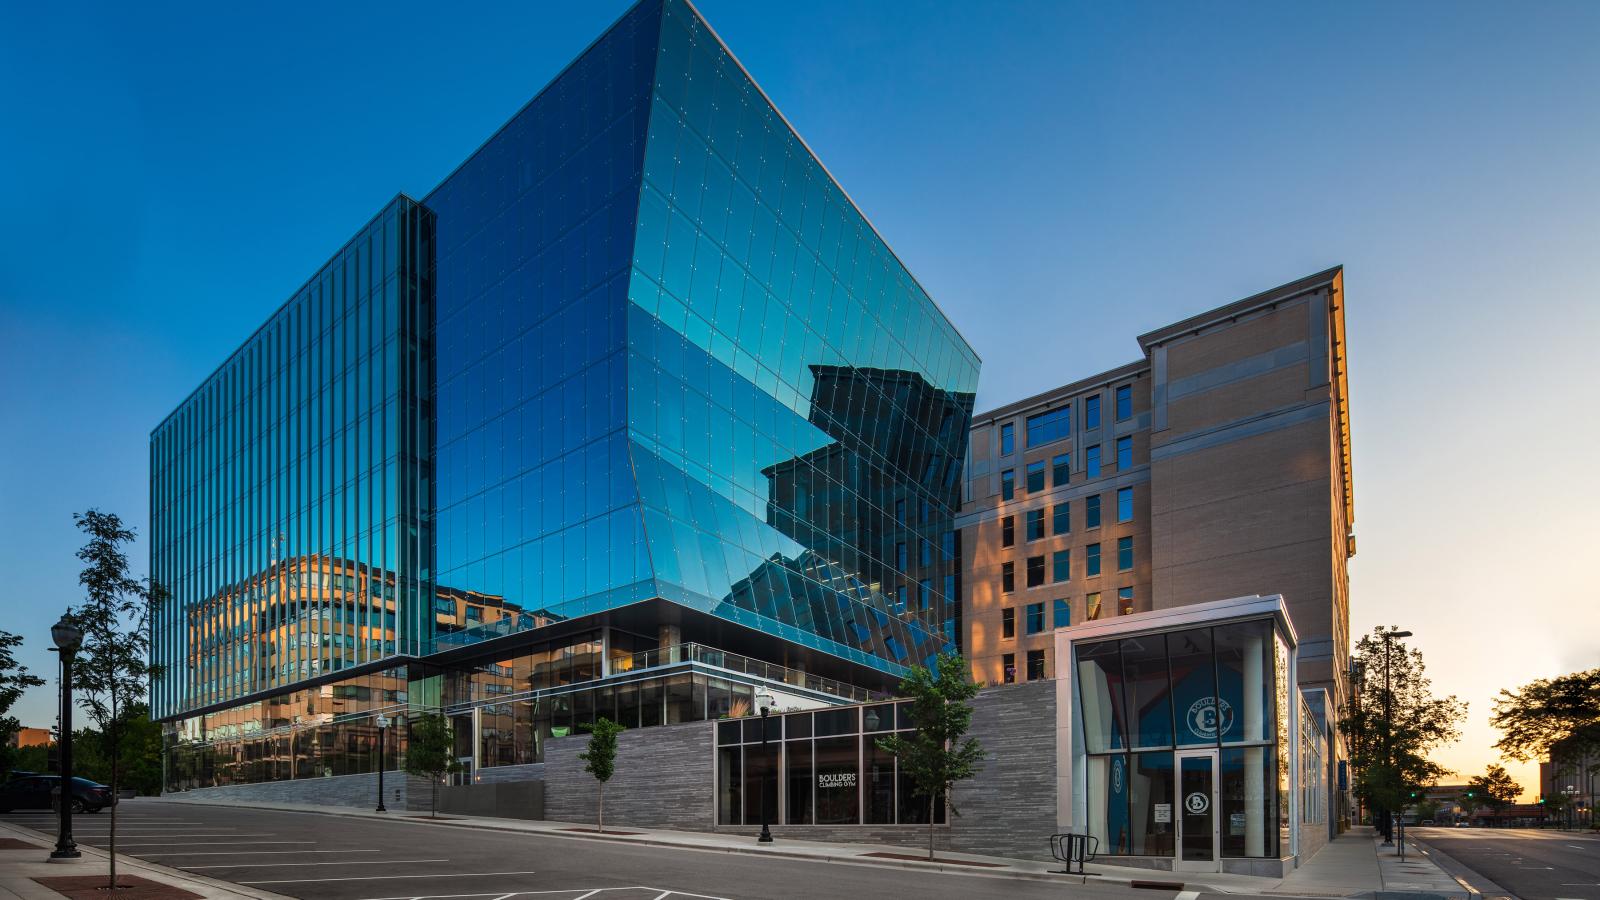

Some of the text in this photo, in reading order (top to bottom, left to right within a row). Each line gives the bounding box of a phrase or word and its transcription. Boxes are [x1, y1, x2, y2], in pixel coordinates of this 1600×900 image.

[1191, 698, 1229, 713] BOULDRS
[819, 773, 856, 782] BOULDERS
[1192, 796, 1204, 809] B
